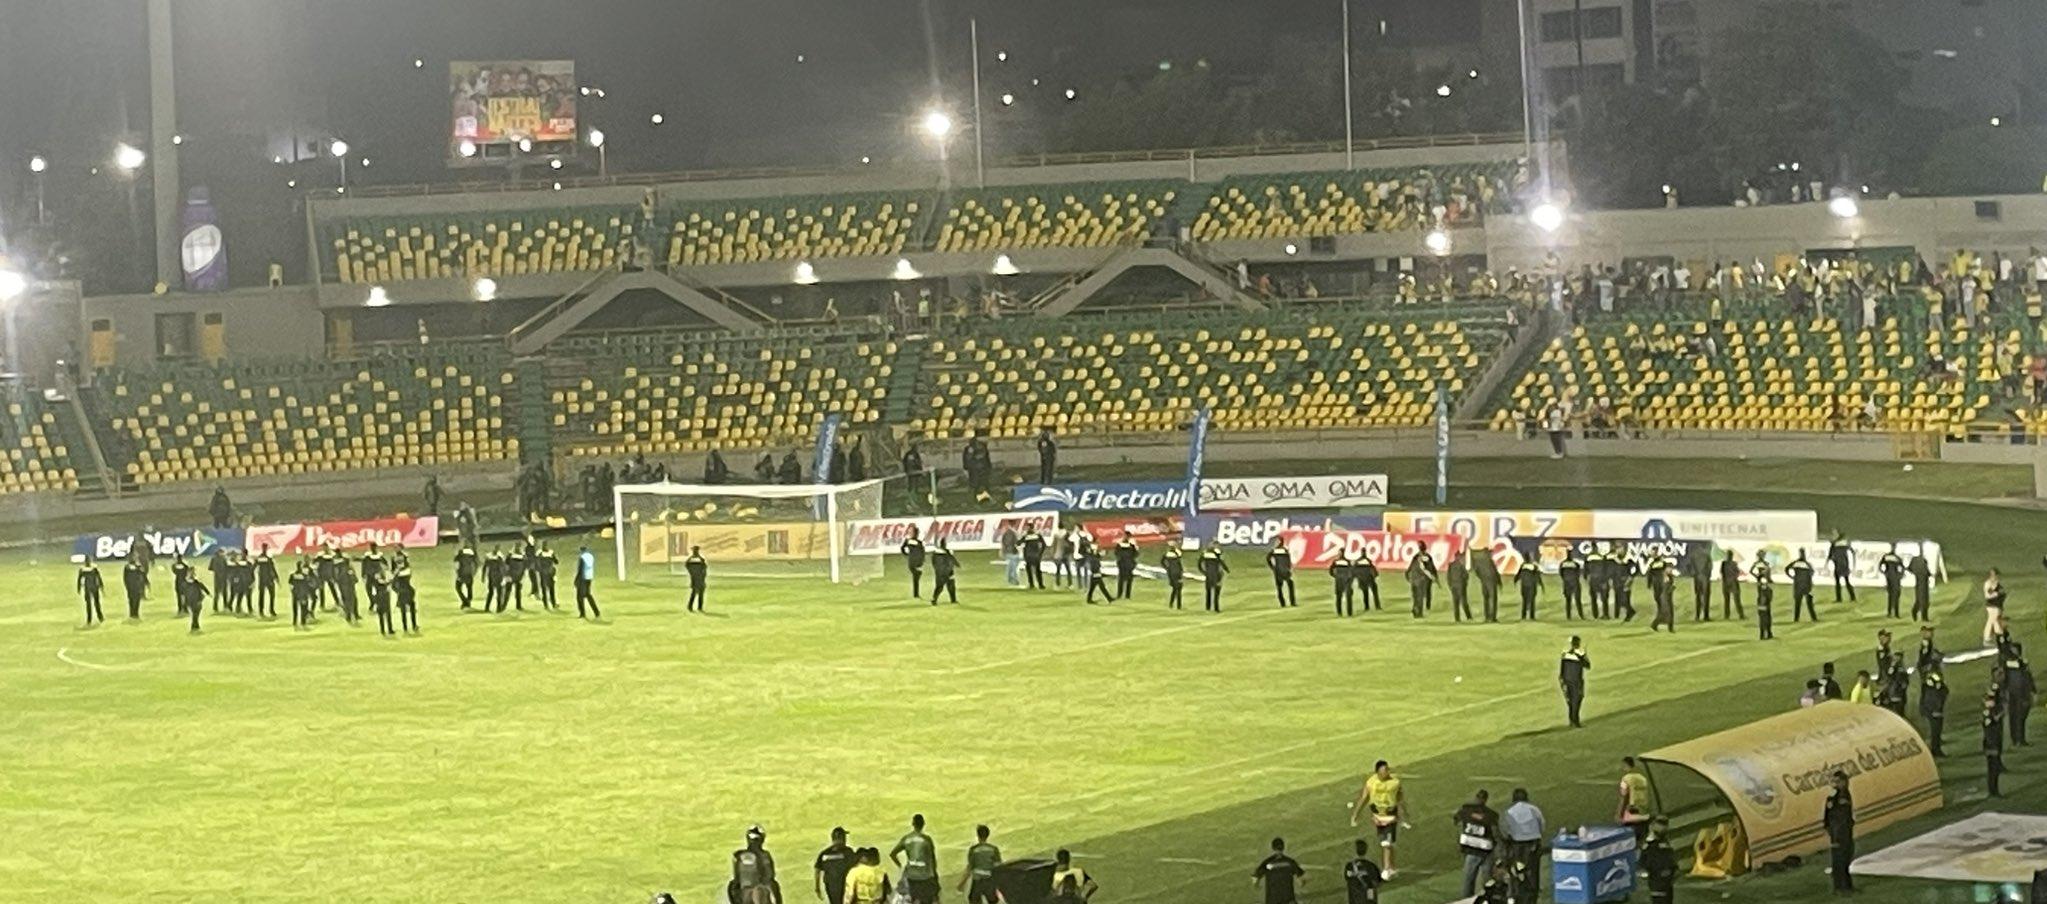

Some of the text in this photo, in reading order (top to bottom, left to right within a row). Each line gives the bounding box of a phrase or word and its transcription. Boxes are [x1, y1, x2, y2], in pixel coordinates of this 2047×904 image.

[1263, 482, 1316, 499] OMA
[1329, 480, 1382, 497] OMA
[1680, 521, 1768, 536] UNITECNAR
